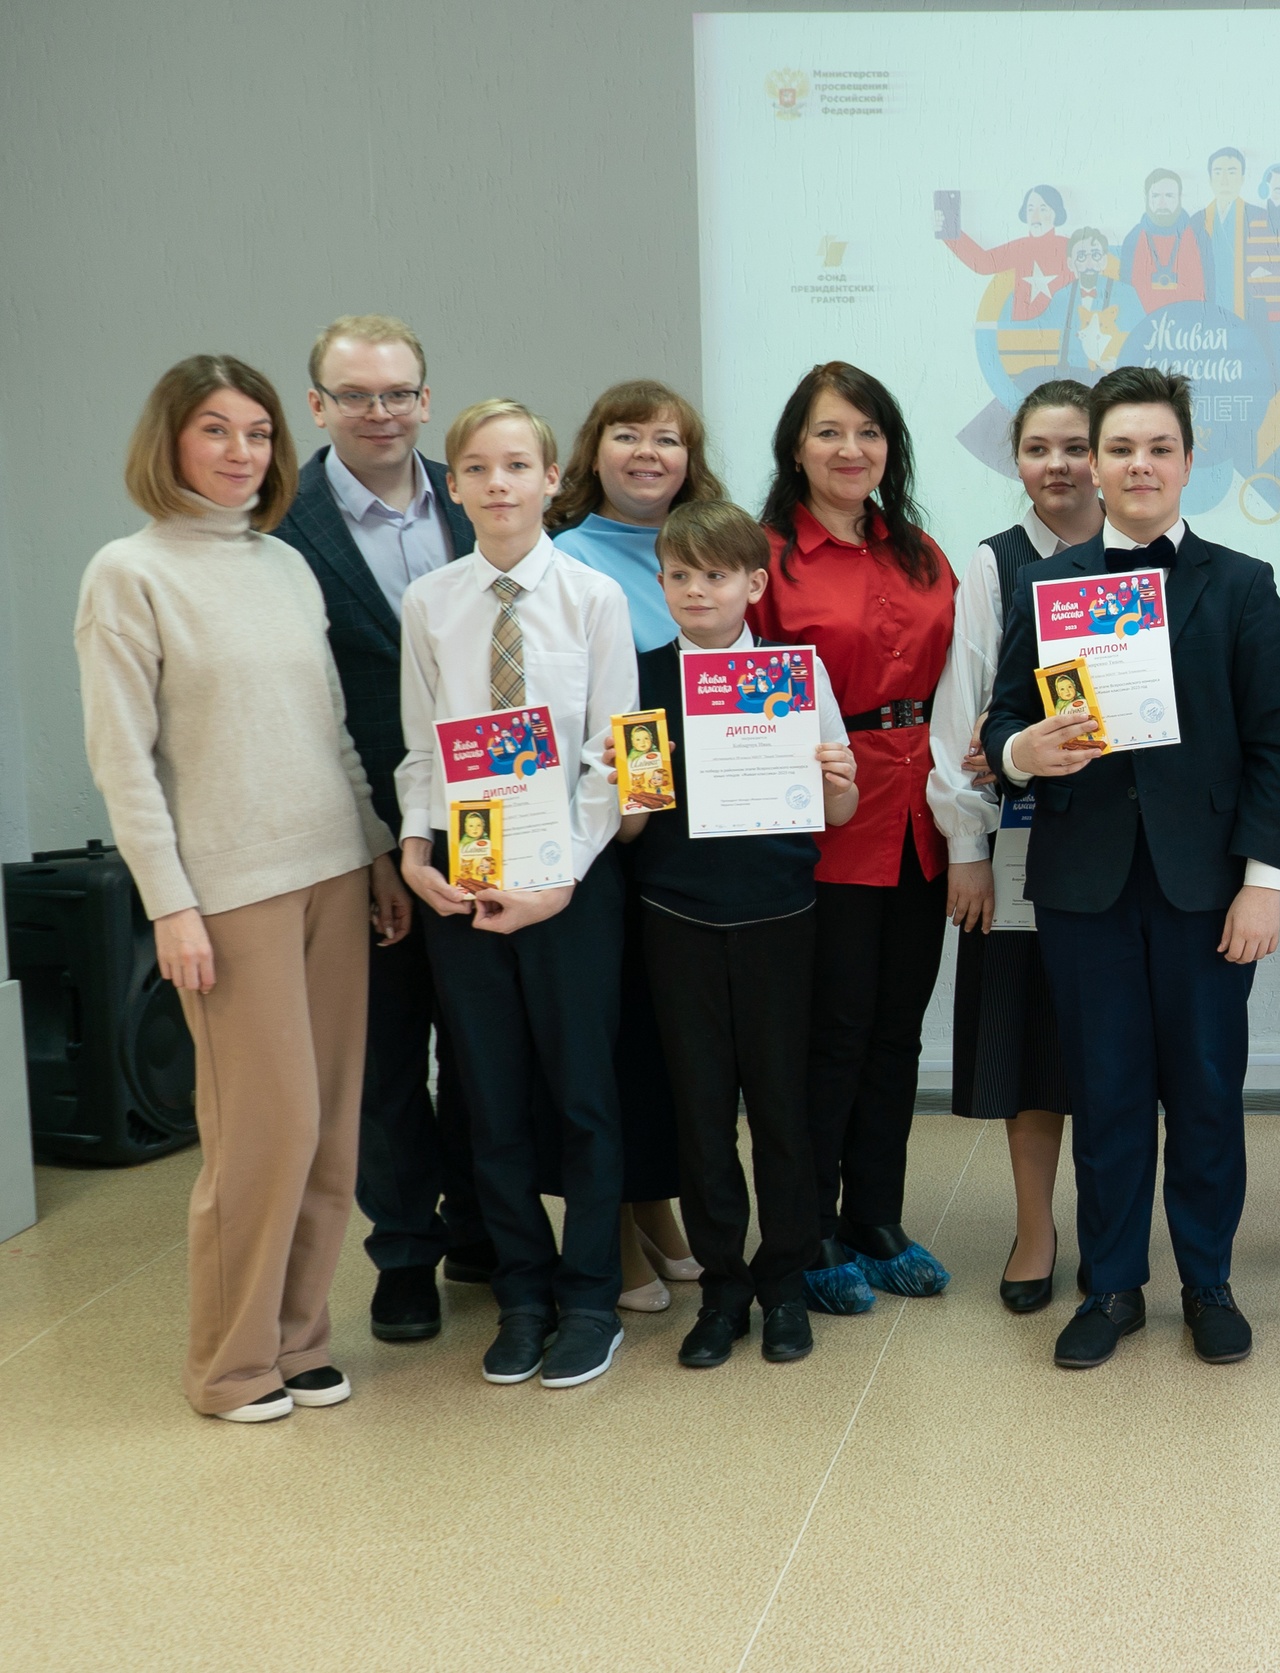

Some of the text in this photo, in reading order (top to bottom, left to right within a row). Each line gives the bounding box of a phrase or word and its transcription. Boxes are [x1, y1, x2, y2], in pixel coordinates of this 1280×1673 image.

[812, 70, 890, 80] Министерство
[814, 83, 888, 92] просвещения
[820, 94, 884, 103] Российской
[822, 106, 882, 116] Федерации
[790, 285, 874, 293] ПРЕЗИДЕНТСКИХ
[811, 296, 856, 304] ГРАНТОВ
[1143, 311, 1228, 352] Живая
[1051, 600, 1078, 612] Живая
[1052, 610, 1084, 622] классика
[1079, 642, 1128, 657] ДИПЛОМ
[698, 672, 727, 684] Живая
[726, 724, 777, 737] ДИПЛОМ
[482, 784, 528, 800] ДИПЛОМ
